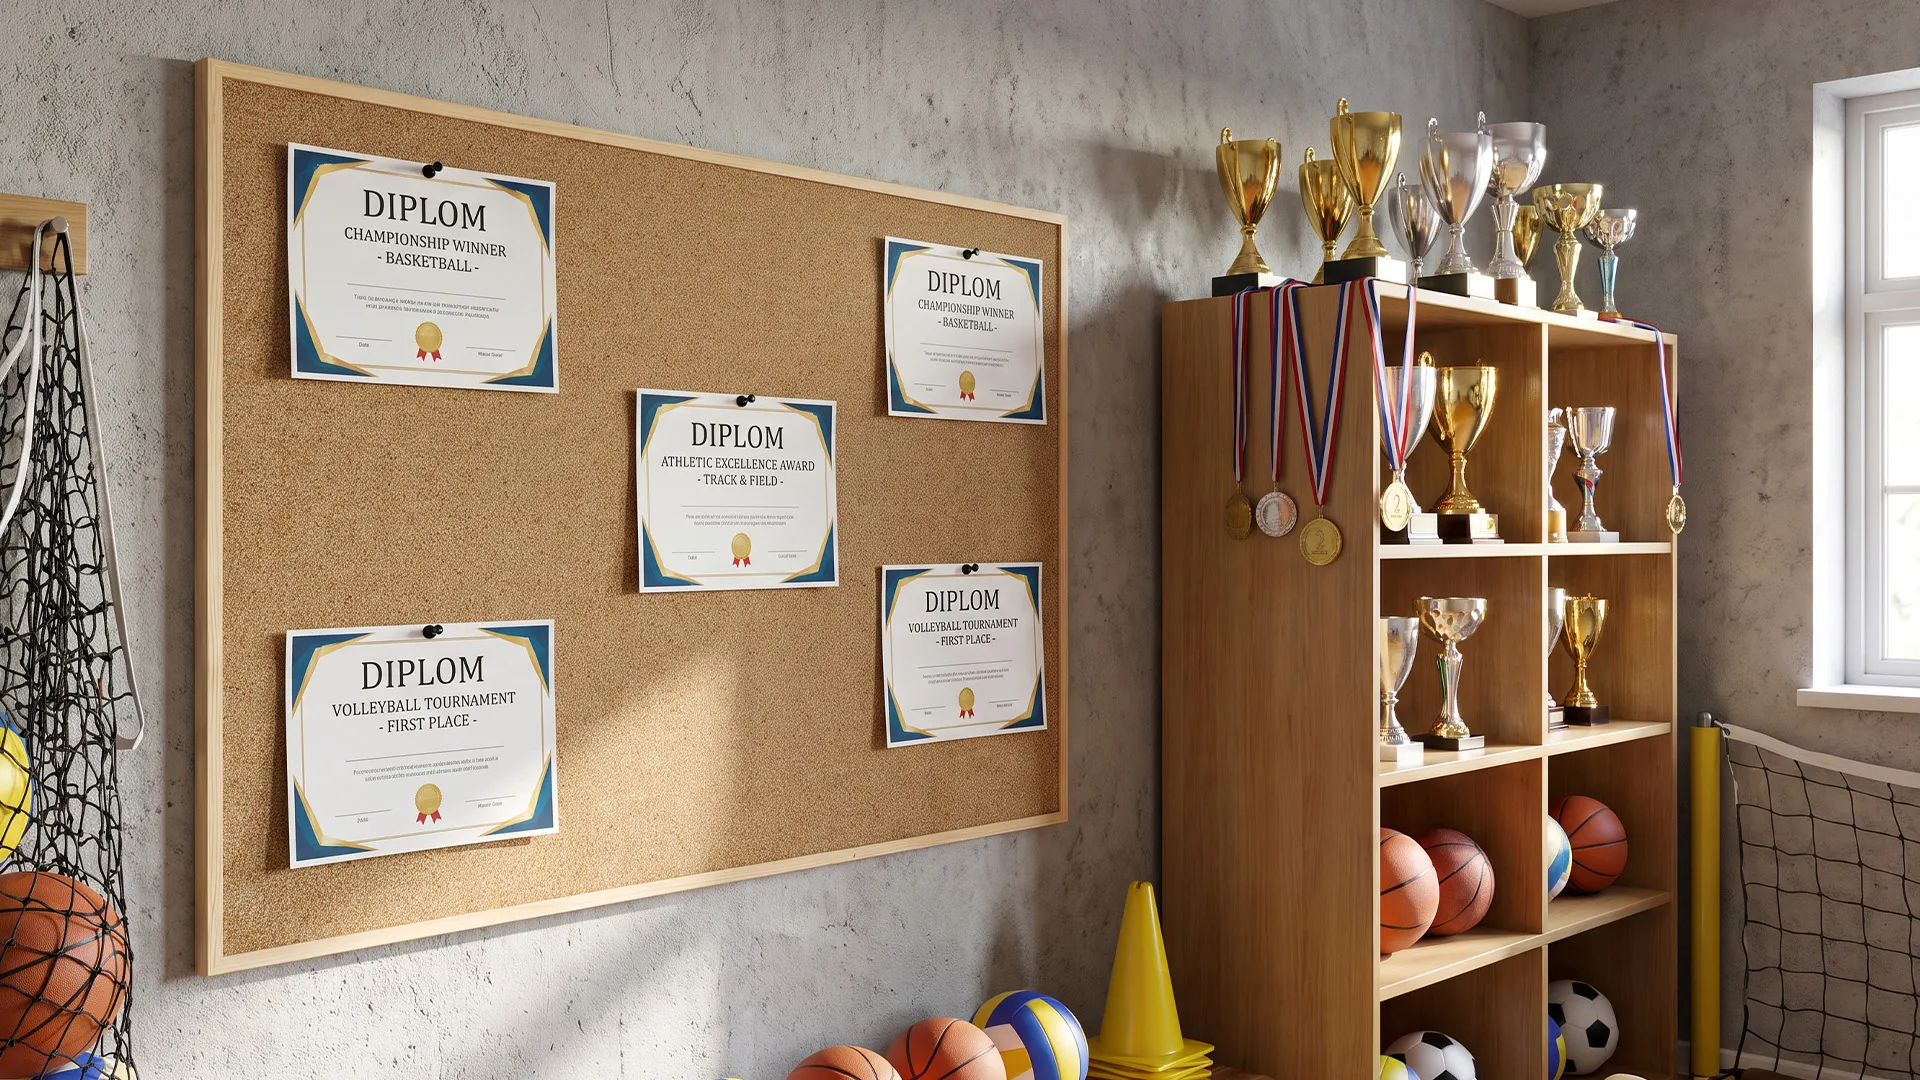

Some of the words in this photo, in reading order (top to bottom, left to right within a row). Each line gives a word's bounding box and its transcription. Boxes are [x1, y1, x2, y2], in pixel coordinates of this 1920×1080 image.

[363, 189, 486, 232] DIPLOM
[345, 227, 449, 250] CHAMPIONSHIP
[453, 239, 506, 257] WINNER
[386, 251, 471, 272] BASKETBALL
[928, 270, 1001, 300] DIPLOM
[918, 299, 980, 315] CHAMPIONSHIP
[982, 307, 1014, 319] WINNER
[943, 317, 993, 332] BASKETBALL
[691, 422, 783, 449] DIPLOM
[661, 456, 712, 468] ATHLETIC
[716, 458, 777, 470] EXCELLENCE
[780, 460, 815, 471] AWARD
[703, 474, 737, 485] TRACK
[740, 475, 747, 485] &
[750, 475, 777, 486] FIELD
[1394, 494, 1400, 513] 2
[926, 589, 999, 612] DIPLOM
[908, 621, 961, 633] VOLLEYBALL
[962, 618, 1018, 630] TOURNAMENT
[941, 635, 964, 646] FIRST
[966, 634, 991, 644] PLACE
[362, 656, 484, 690] DIPLOM
[332, 699, 421, 717] VOLLEYBALL
[424, 692, 516, 710] TOURNAMENT
[388, 717, 425, 732] FIRST
[429, 714, 469, 729] PLACE
